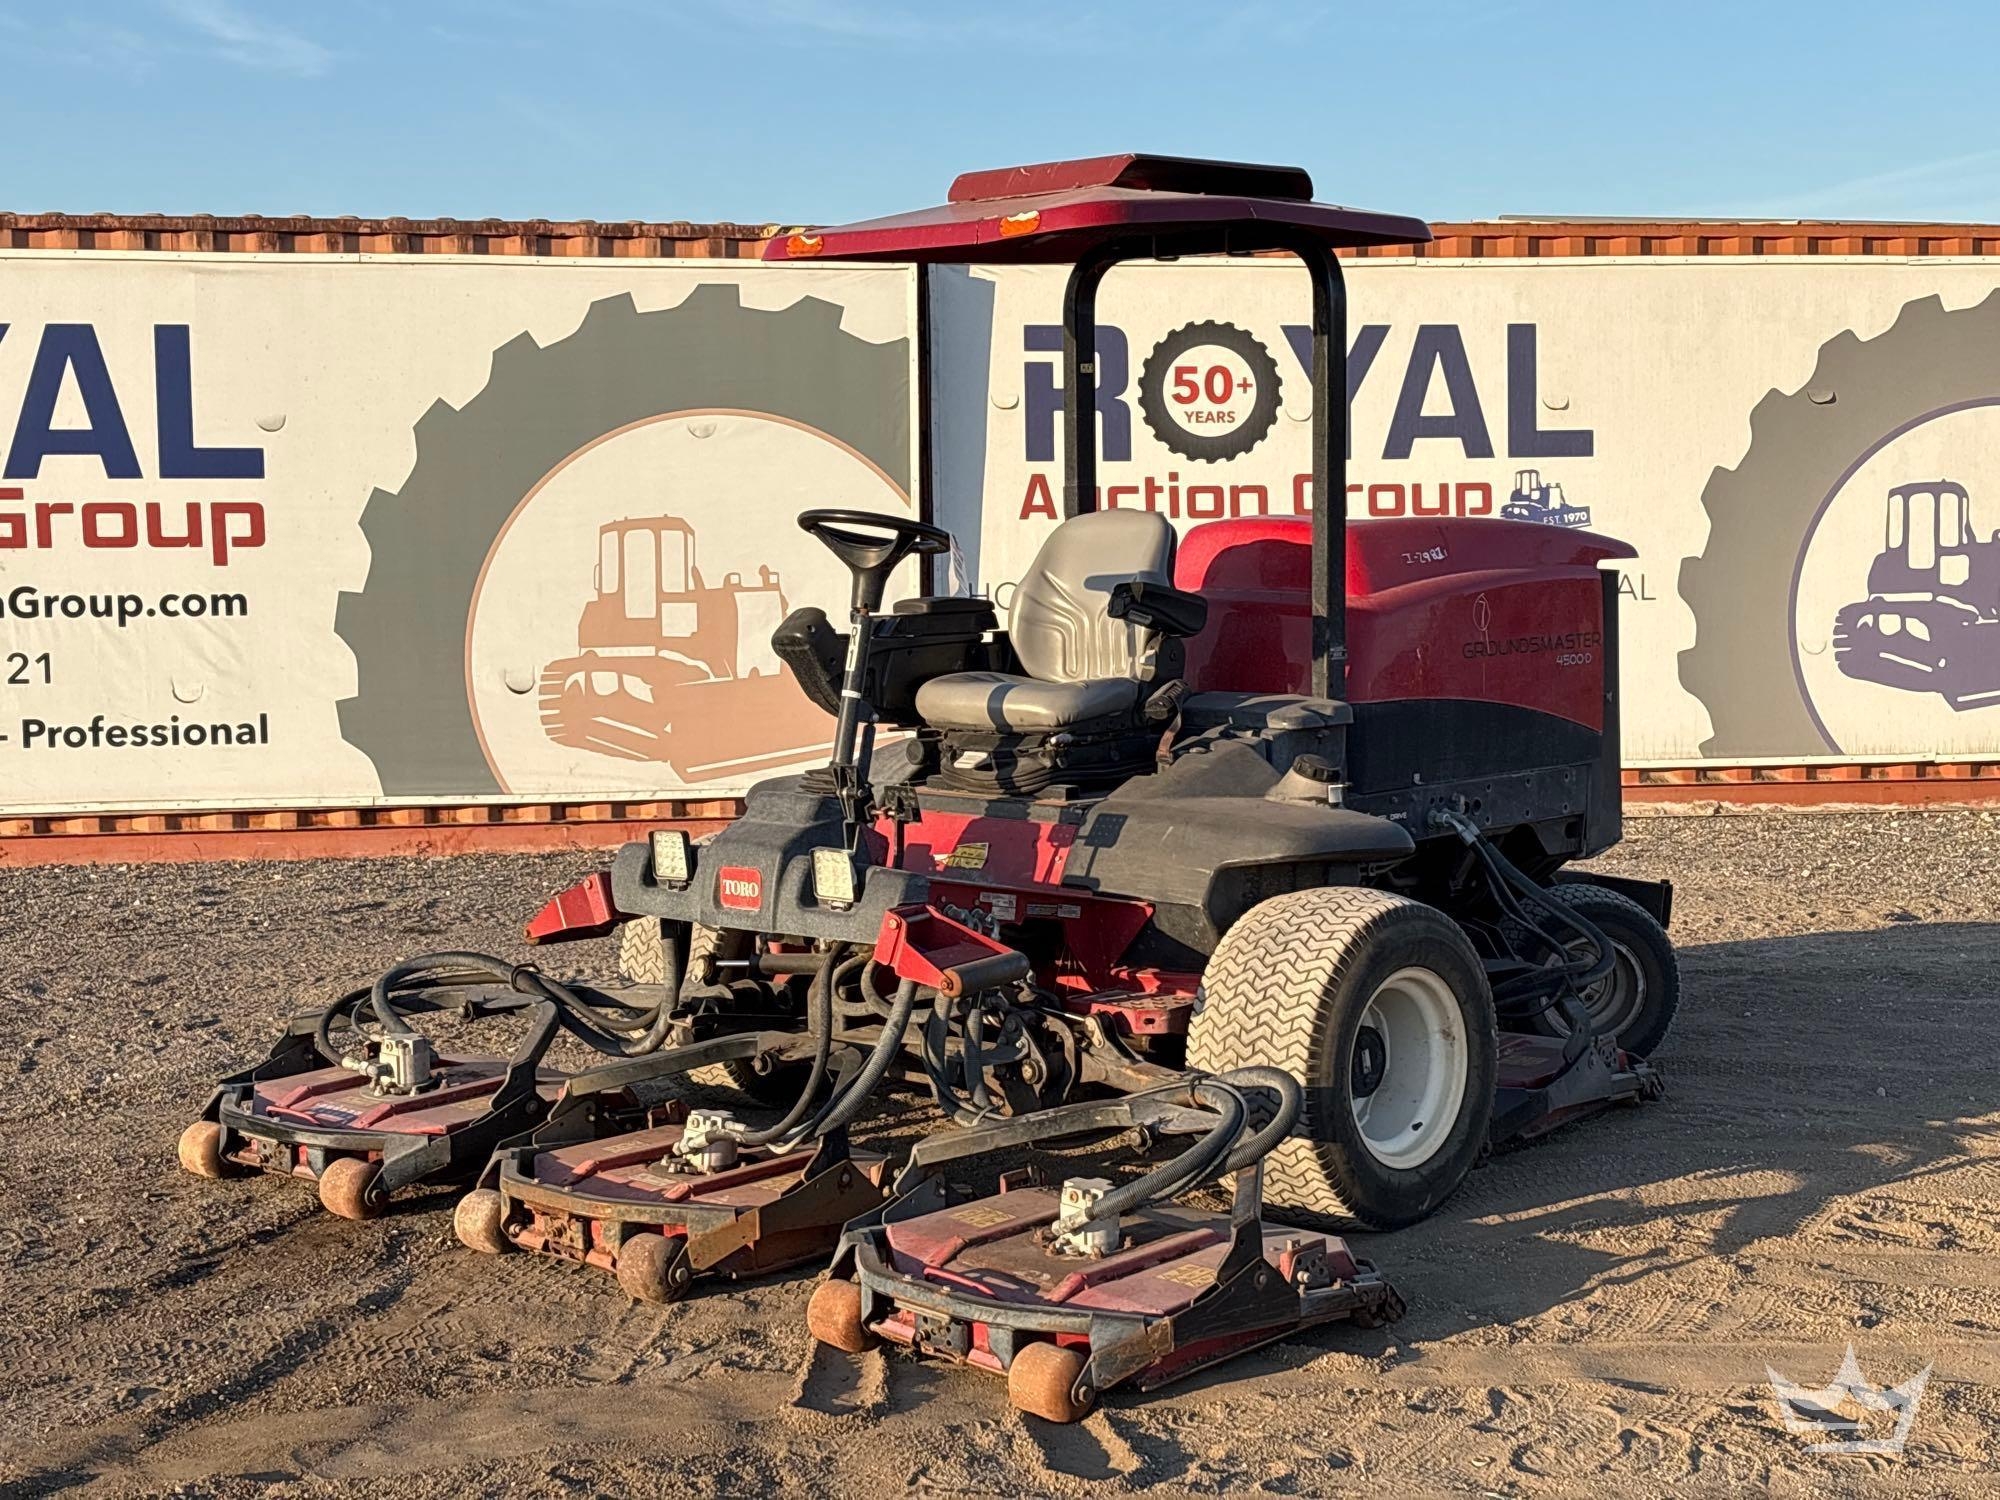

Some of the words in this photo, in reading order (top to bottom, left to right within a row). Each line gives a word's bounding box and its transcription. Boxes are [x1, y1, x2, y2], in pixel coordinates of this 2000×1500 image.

[1171, 365, 1253, 404] 50+
[1184, 411, 1236, 424] YEARS
[1019, 472, 1268, 520] Action
[1563, 511, 1588, 523] 1970
[1463, 631, 1601, 660] GROUNDSMASTER
[7, 652, 51, 684] 21
[22, 713, 269, 749] Professional
[723, 879, 759, 898] TORO
